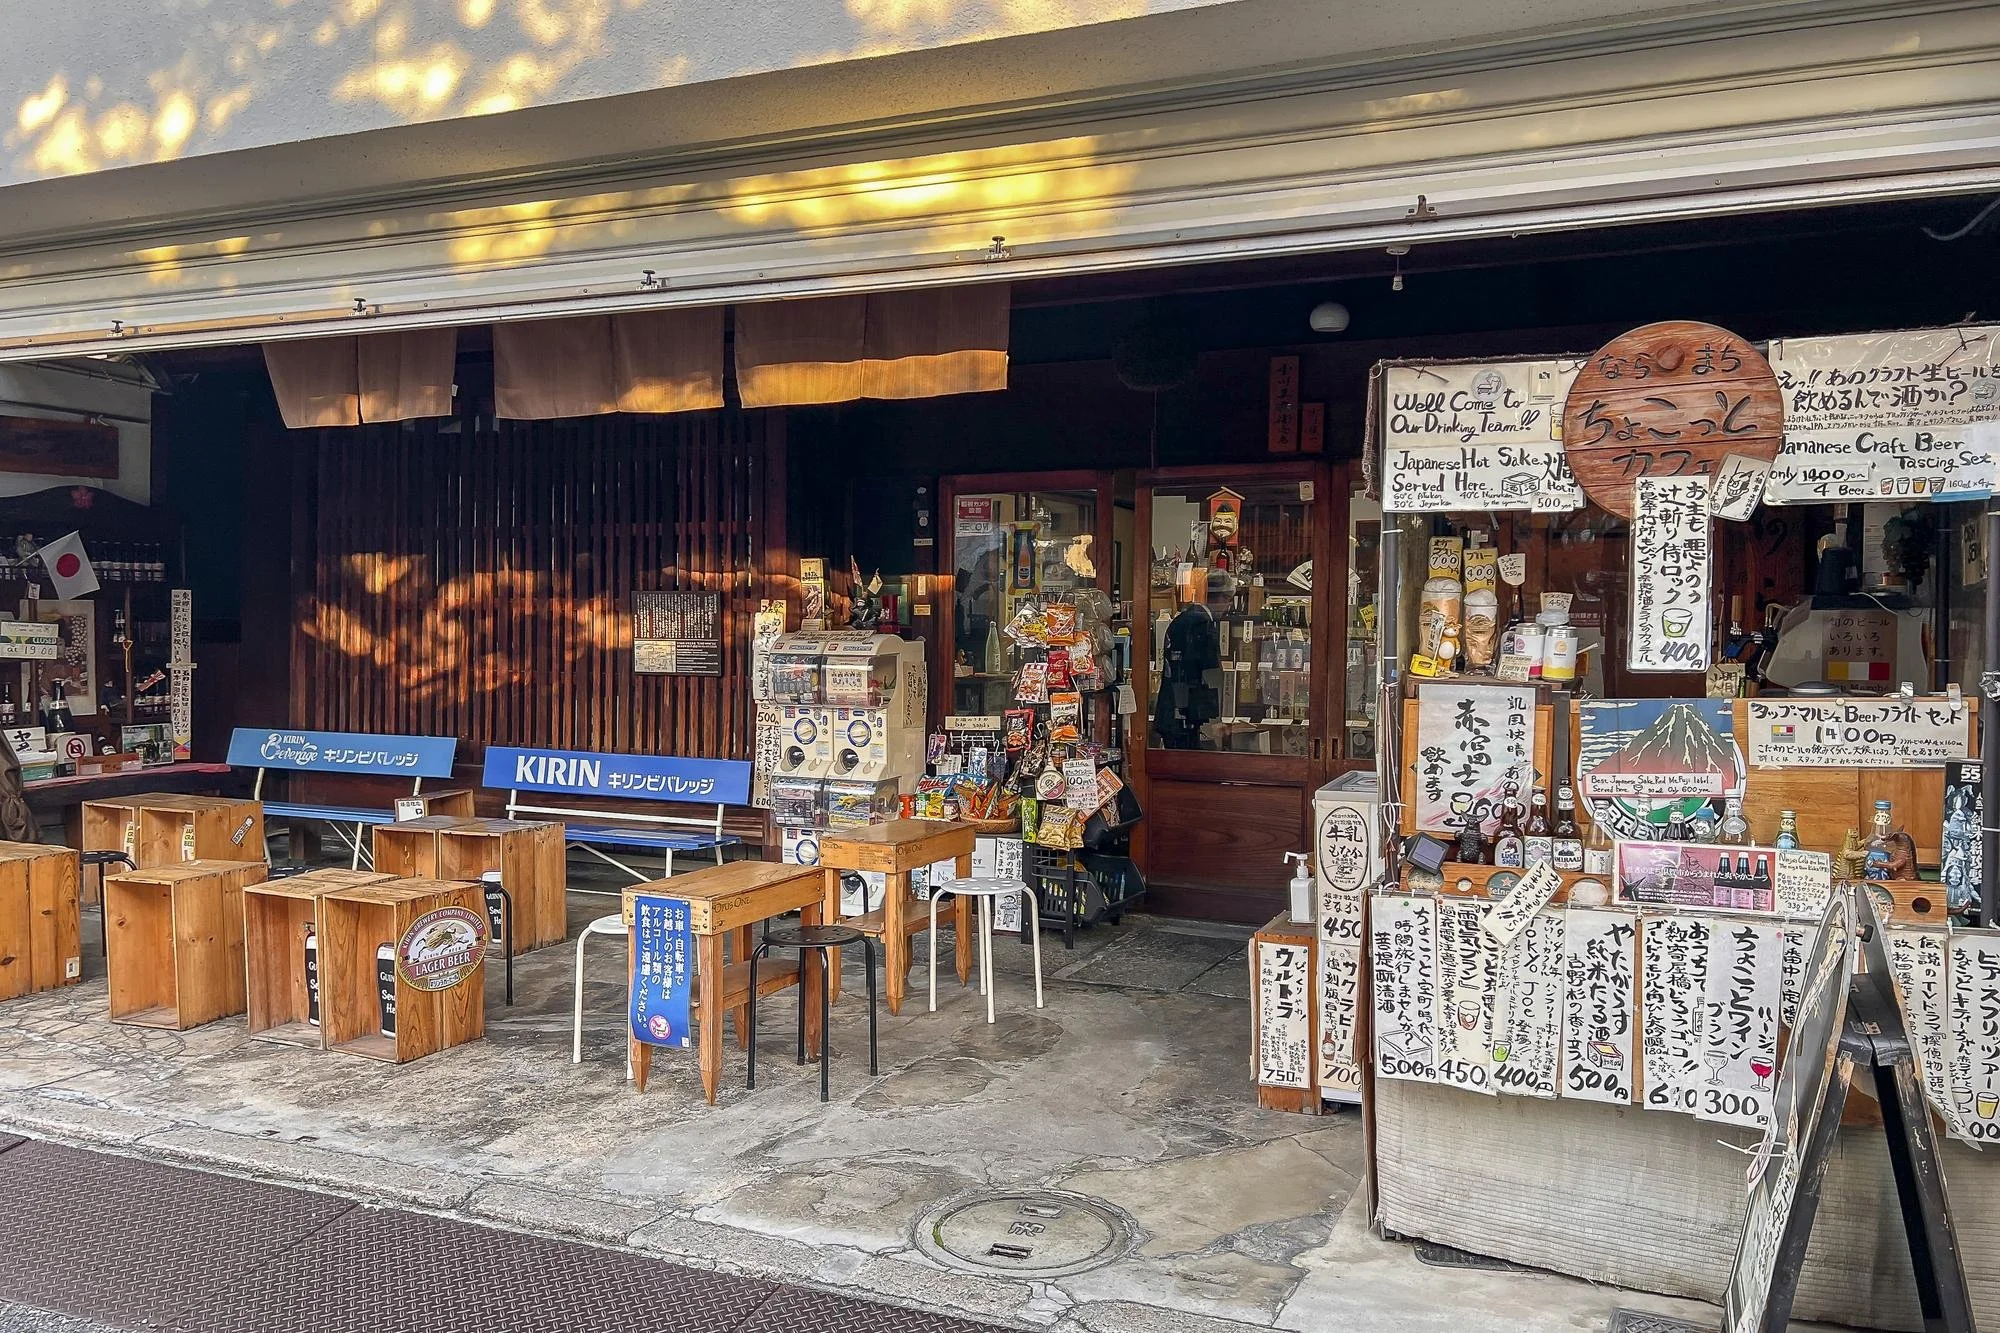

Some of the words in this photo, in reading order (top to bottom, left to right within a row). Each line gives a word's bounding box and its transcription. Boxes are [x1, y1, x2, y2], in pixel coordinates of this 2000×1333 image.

[1503, 388, 1526, 409] to
[1424, 413, 1479, 443] Drinking
[1855, 432, 1909, 454] Craft
[1915, 432, 1964, 452] Beer
[1394, 450, 1460, 476] Japanese
[1461, 447, 1490, 469] Hot
[1612, 448, 1716, 478] カフェ
[1392, 472, 1445, 492] Served
[1769, 466, 1797, 486] only
[1537, 497, 1561, 508] 500
[1829, 631, 1880, 642] いろいろ
[1843, 705, 1879, 724] Beer
[282, 735, 306, 745] KIRIN
[323, 749, 419, 767] キリンビバレッジ
[515, 755, 601, 788] KIRIN
[607, 772, 715, 795] キリンビバレッジ
[1420, 746, 1451, 802] 飲めます
[1960, 767, 1981, 780] 55
[1326, 824, 1363, 842] 牛乳
[1329, 845, 1363, 859] もなか
[402, 930, 416, 949] KIRIN
[414, 912, 437, 932] BREWERY
[439, 908, 464, 918] COMPANY
[465, 912, 483, 930] LIMITED
[652, 906, 663, 986] アルコール類の
[661, 907, 673, 1000] お越しのお客様は
[675, 908, 685, 986] お車・自転車で
[415, 958, 446, 976] LAGER
[447, 952, 471, 966] BEER
[637, 905, 651, 1028] 飲食はご遠慮ください。
[1274, 948, 1294, 1019] ウルトラ
[1604, 923, 1635, 1036] やたがらす
[1728, 926, 1760, 1060] ちょこっとワイン
[1381, 1053, 1437, 1080] 500円
[1568, 1062, 1629, 1101] 500円
